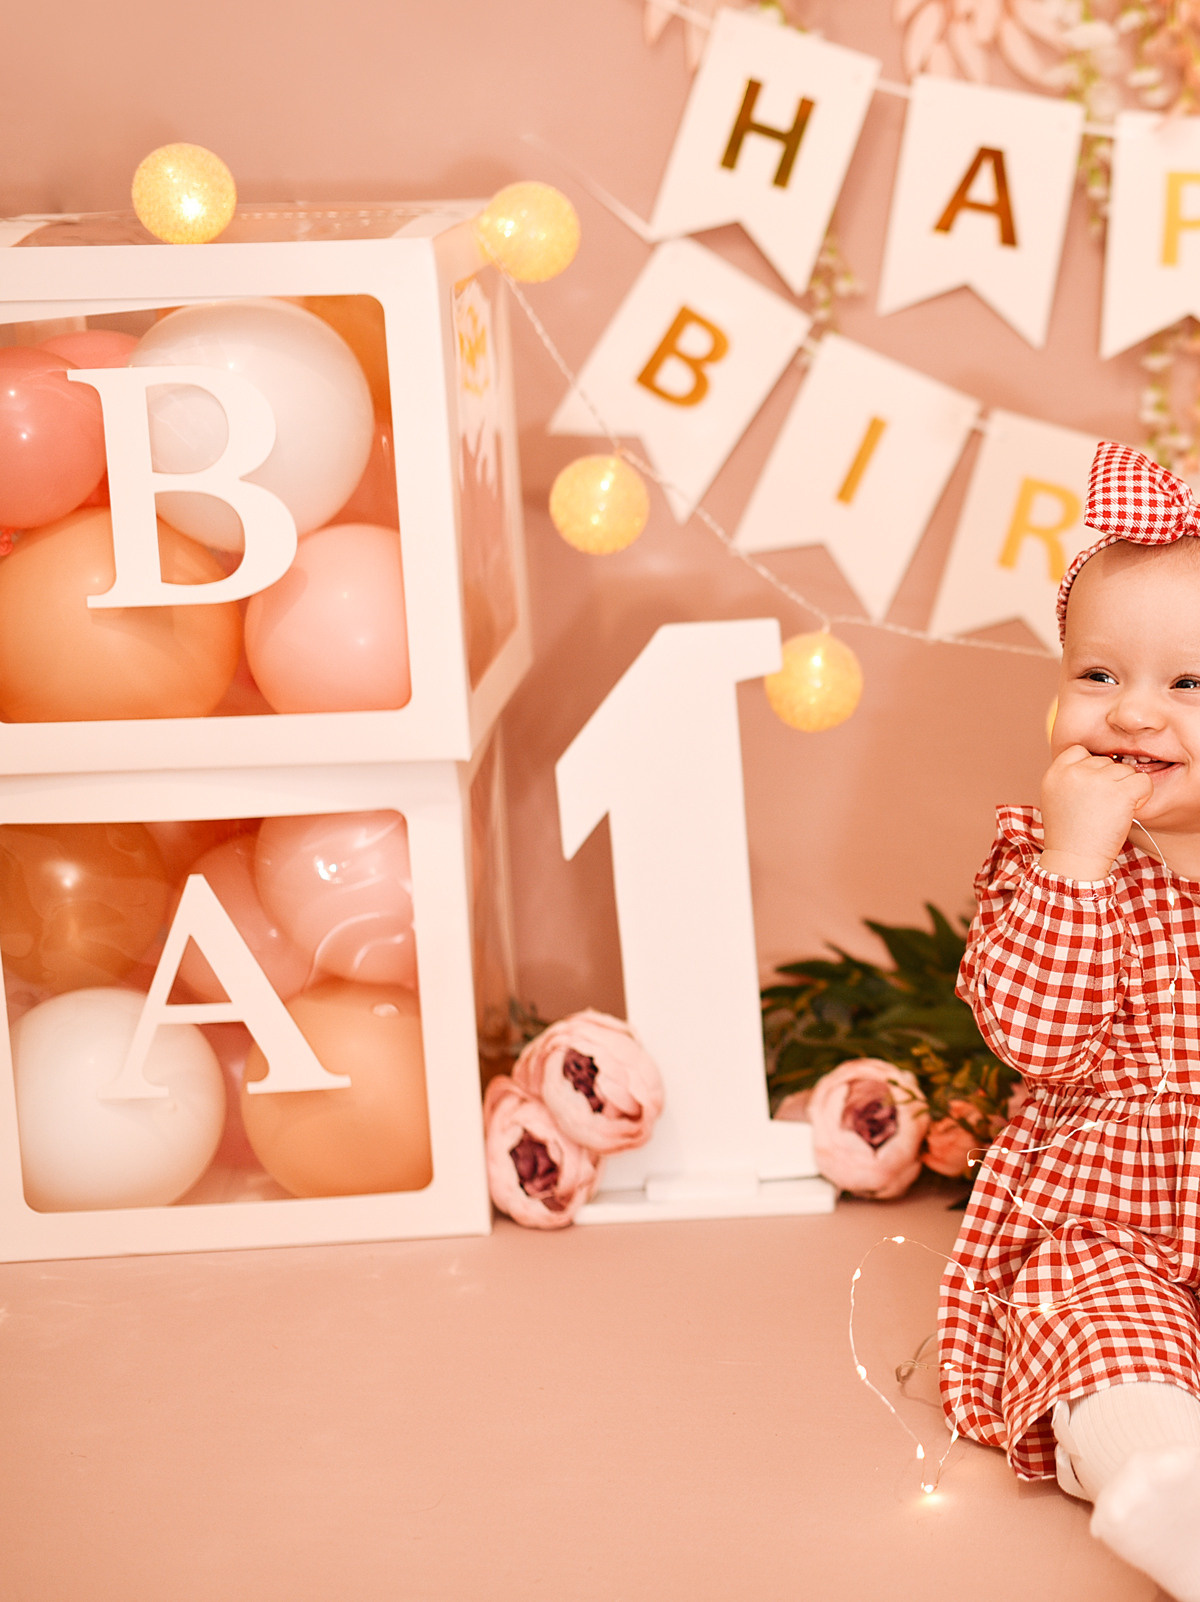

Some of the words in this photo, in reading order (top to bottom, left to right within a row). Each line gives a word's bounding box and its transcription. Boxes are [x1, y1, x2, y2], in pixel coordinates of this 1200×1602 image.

[66, 364, 298, 609] B
[96, 873, 352, 1100] A
[554, 617, 820, 1190] 1
